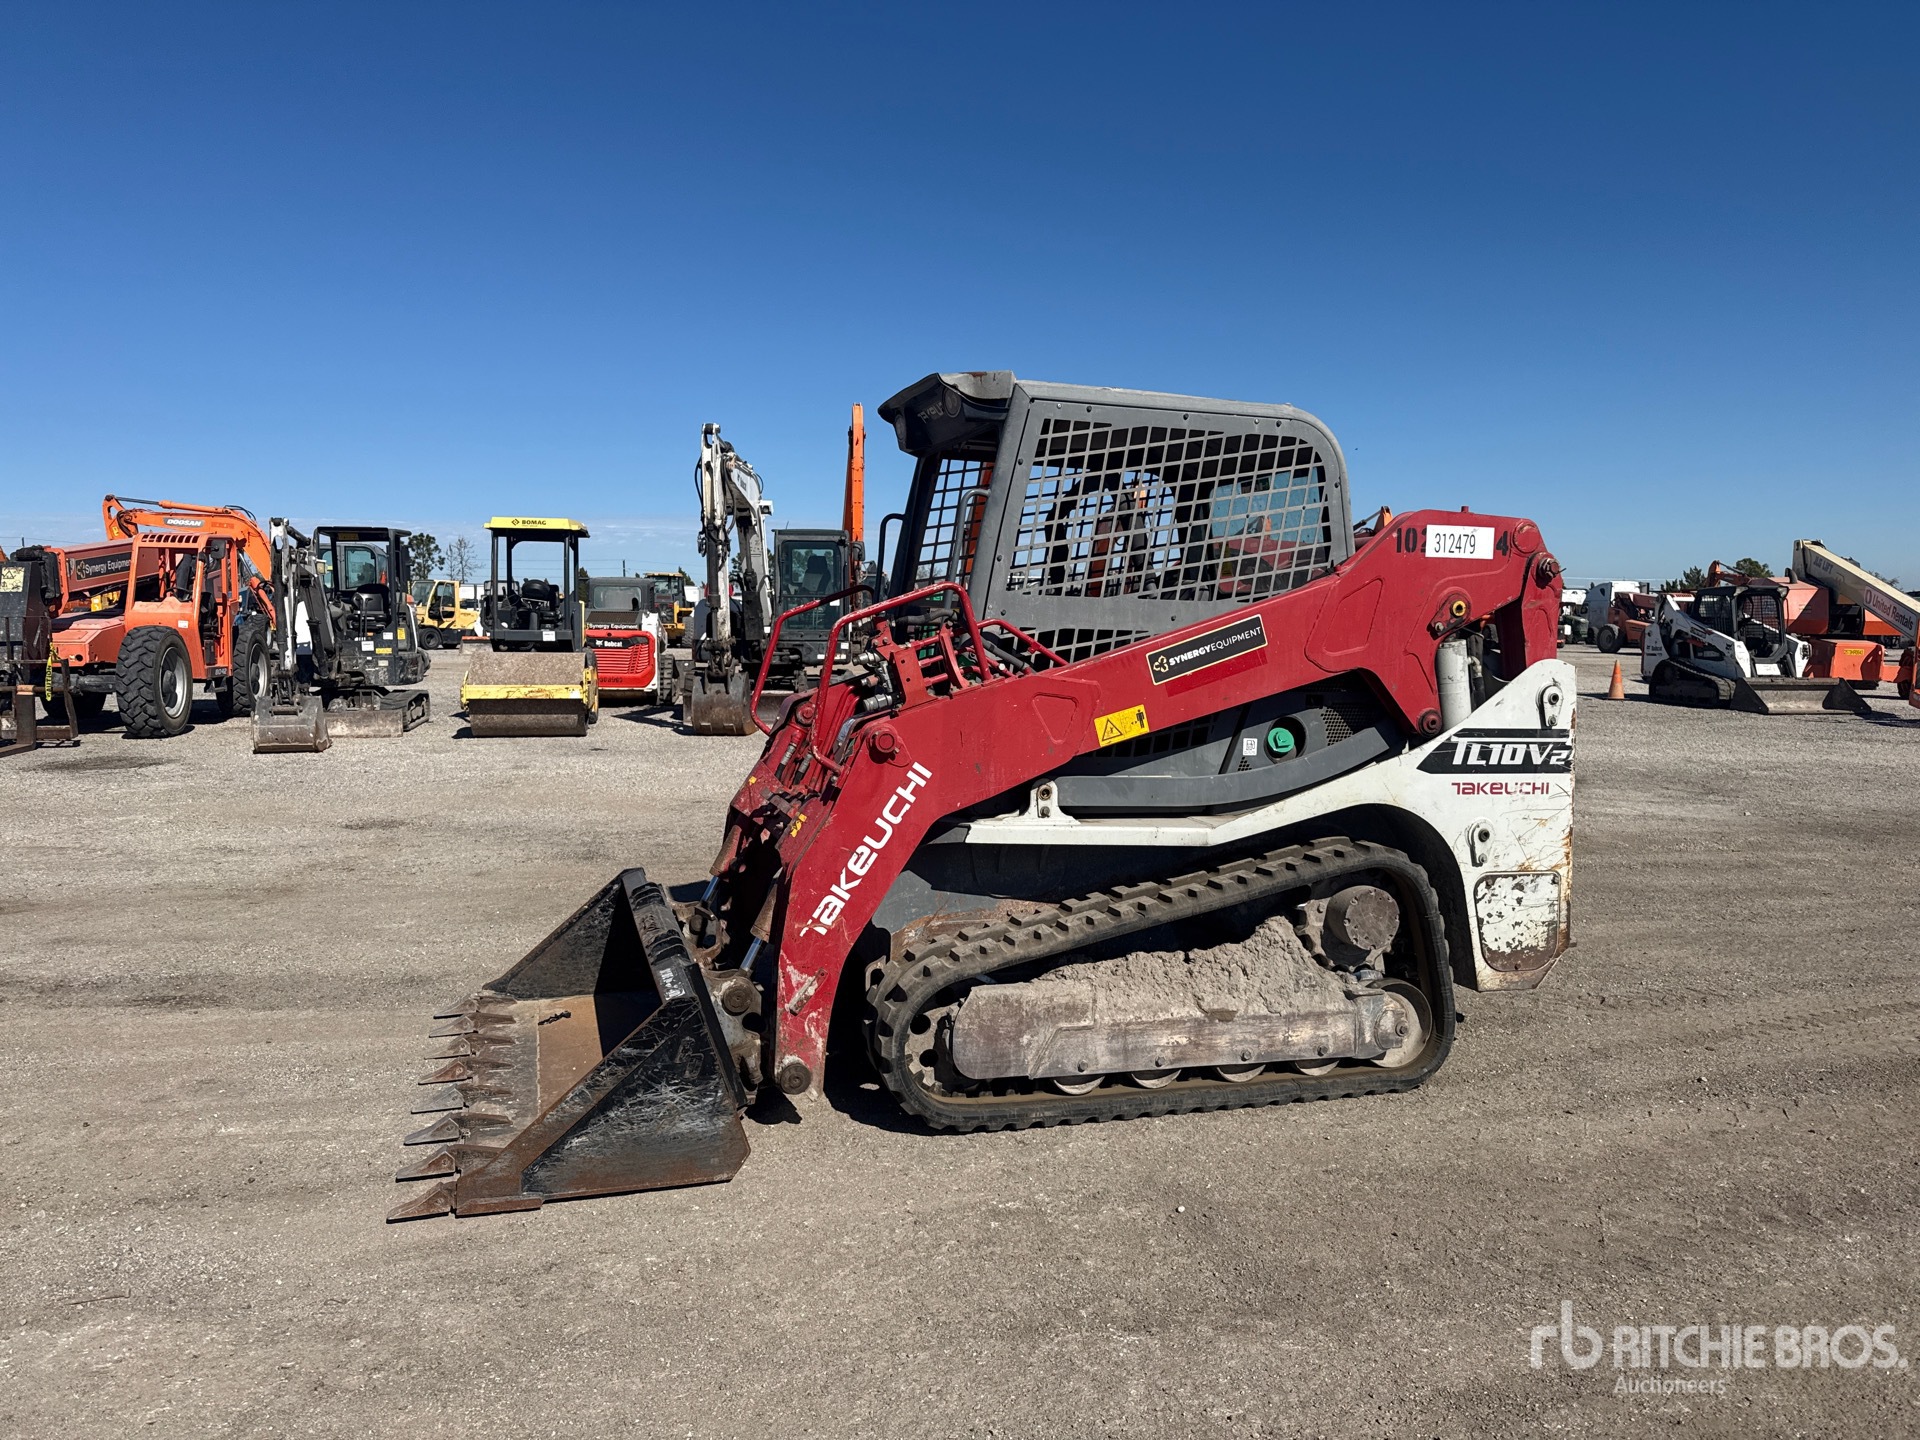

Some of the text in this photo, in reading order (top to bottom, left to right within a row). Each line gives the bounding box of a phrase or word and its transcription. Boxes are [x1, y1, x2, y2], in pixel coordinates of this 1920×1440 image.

[166, 519, 202, 527] DOOSAN
[1434, 533, 1476, 554] 312479
[85, 563, 107, 575] Synergy
[1823, 559, 1834, 574] LIFT
[1872, 594, 1914, 631] United Rentals
